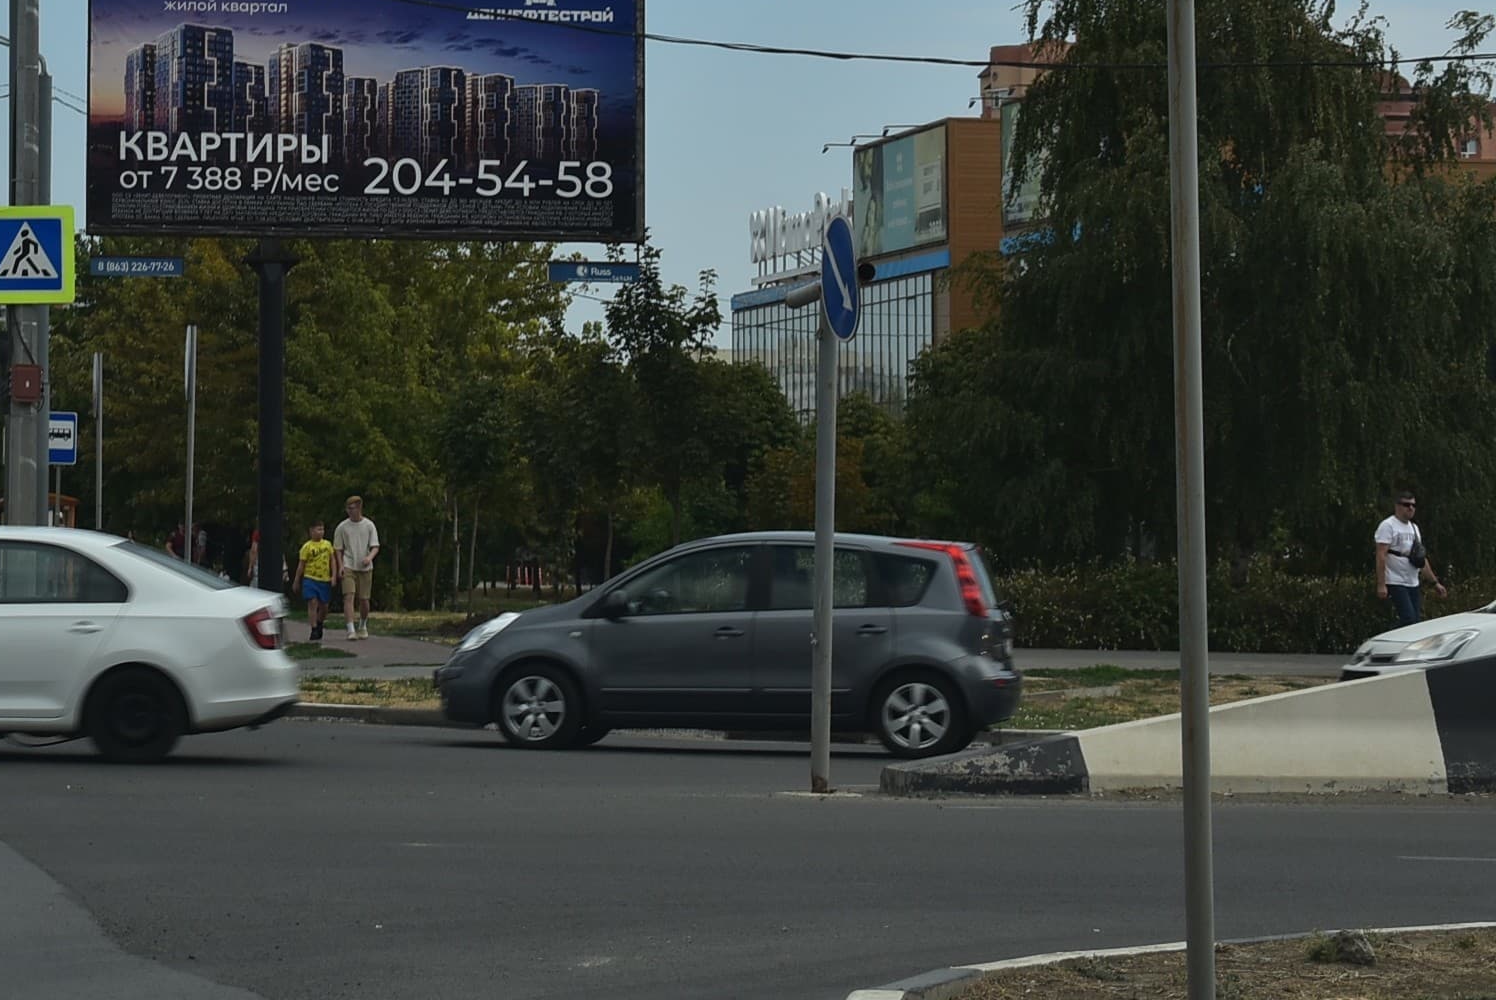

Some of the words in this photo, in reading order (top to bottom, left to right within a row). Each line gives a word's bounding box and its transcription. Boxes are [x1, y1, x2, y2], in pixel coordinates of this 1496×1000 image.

[220, 1, 288, 16] квартал
[119, 130, 329, 165] КВАРТИРЫ
[119, 170, 153, 189] от
[160, 166, 178, 190] 7
[186, 166, 242, 191] 388
[362, 156, 614, 199] 204-54-58
[97, 261, 104, 272] 8
[106, 260, 129, 273] (863)
[131, 261, 175, 272] 226-77-26
[590, 267, 612, 277] Russ
